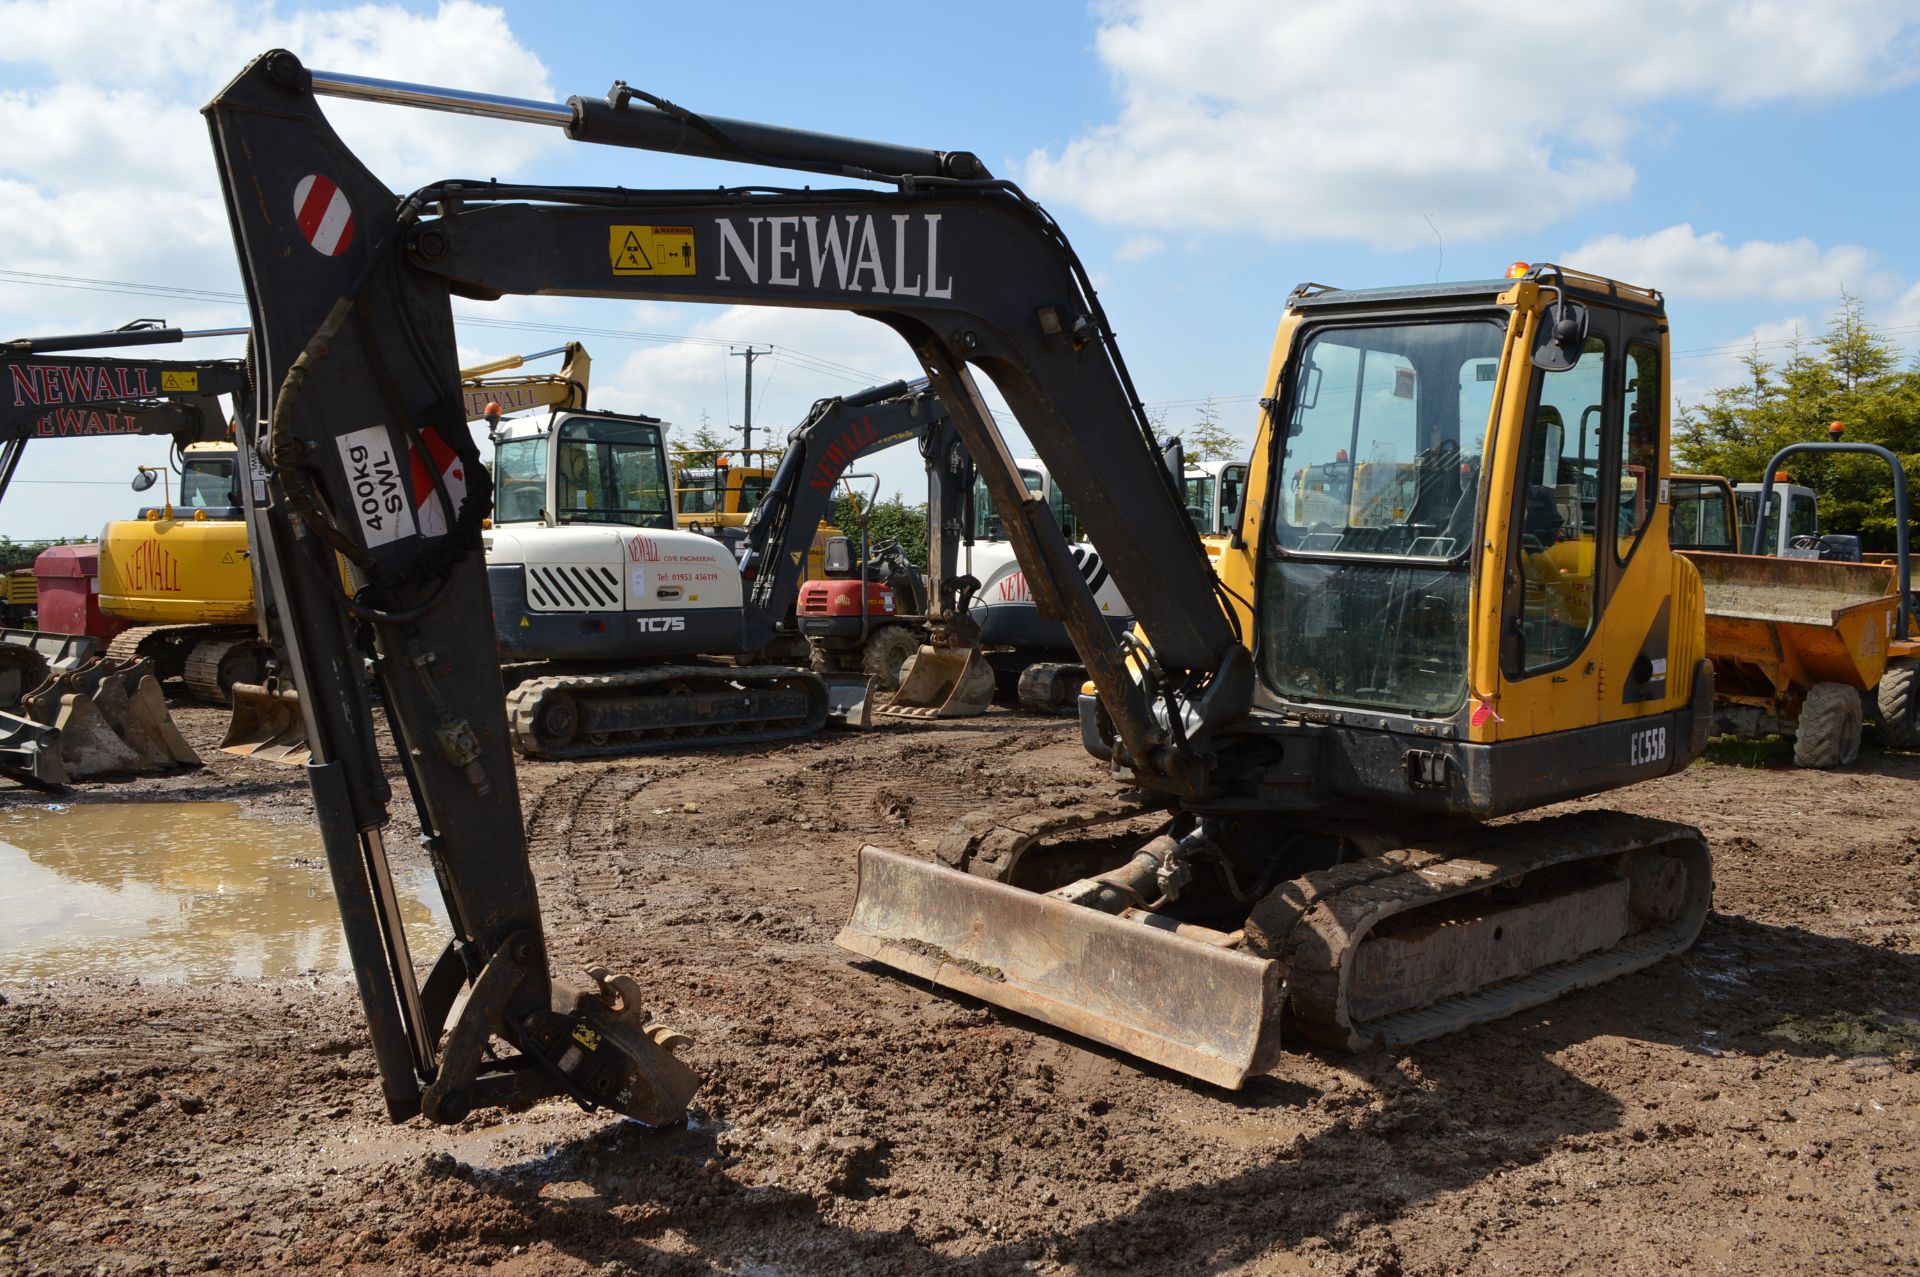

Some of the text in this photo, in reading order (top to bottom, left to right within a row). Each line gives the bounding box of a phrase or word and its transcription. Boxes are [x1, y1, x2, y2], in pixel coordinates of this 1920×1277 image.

[659, 226, 692, 234] WARNING
[714, 214, 952, 299] NEWALL
[8, 364, 157, 407] NEWALL
[37, 408, 143, 436] EWALL
[809, 415, 879, 497] NEWALL
[350, 445, 383, 531] 400kg
[373, 451, 403, 514] SWL
[124, 536, 182, 592] NEWALL
[628, 534, 661, 562] NEWALL
[657, 573, 670, 581] Tel:
[672, 573, 692, 581] 01953
[998, 571, 1032, 602] NEW
[637, 617, 685, 633] TC75
[1631, 727, 1666, 766] EC55B
